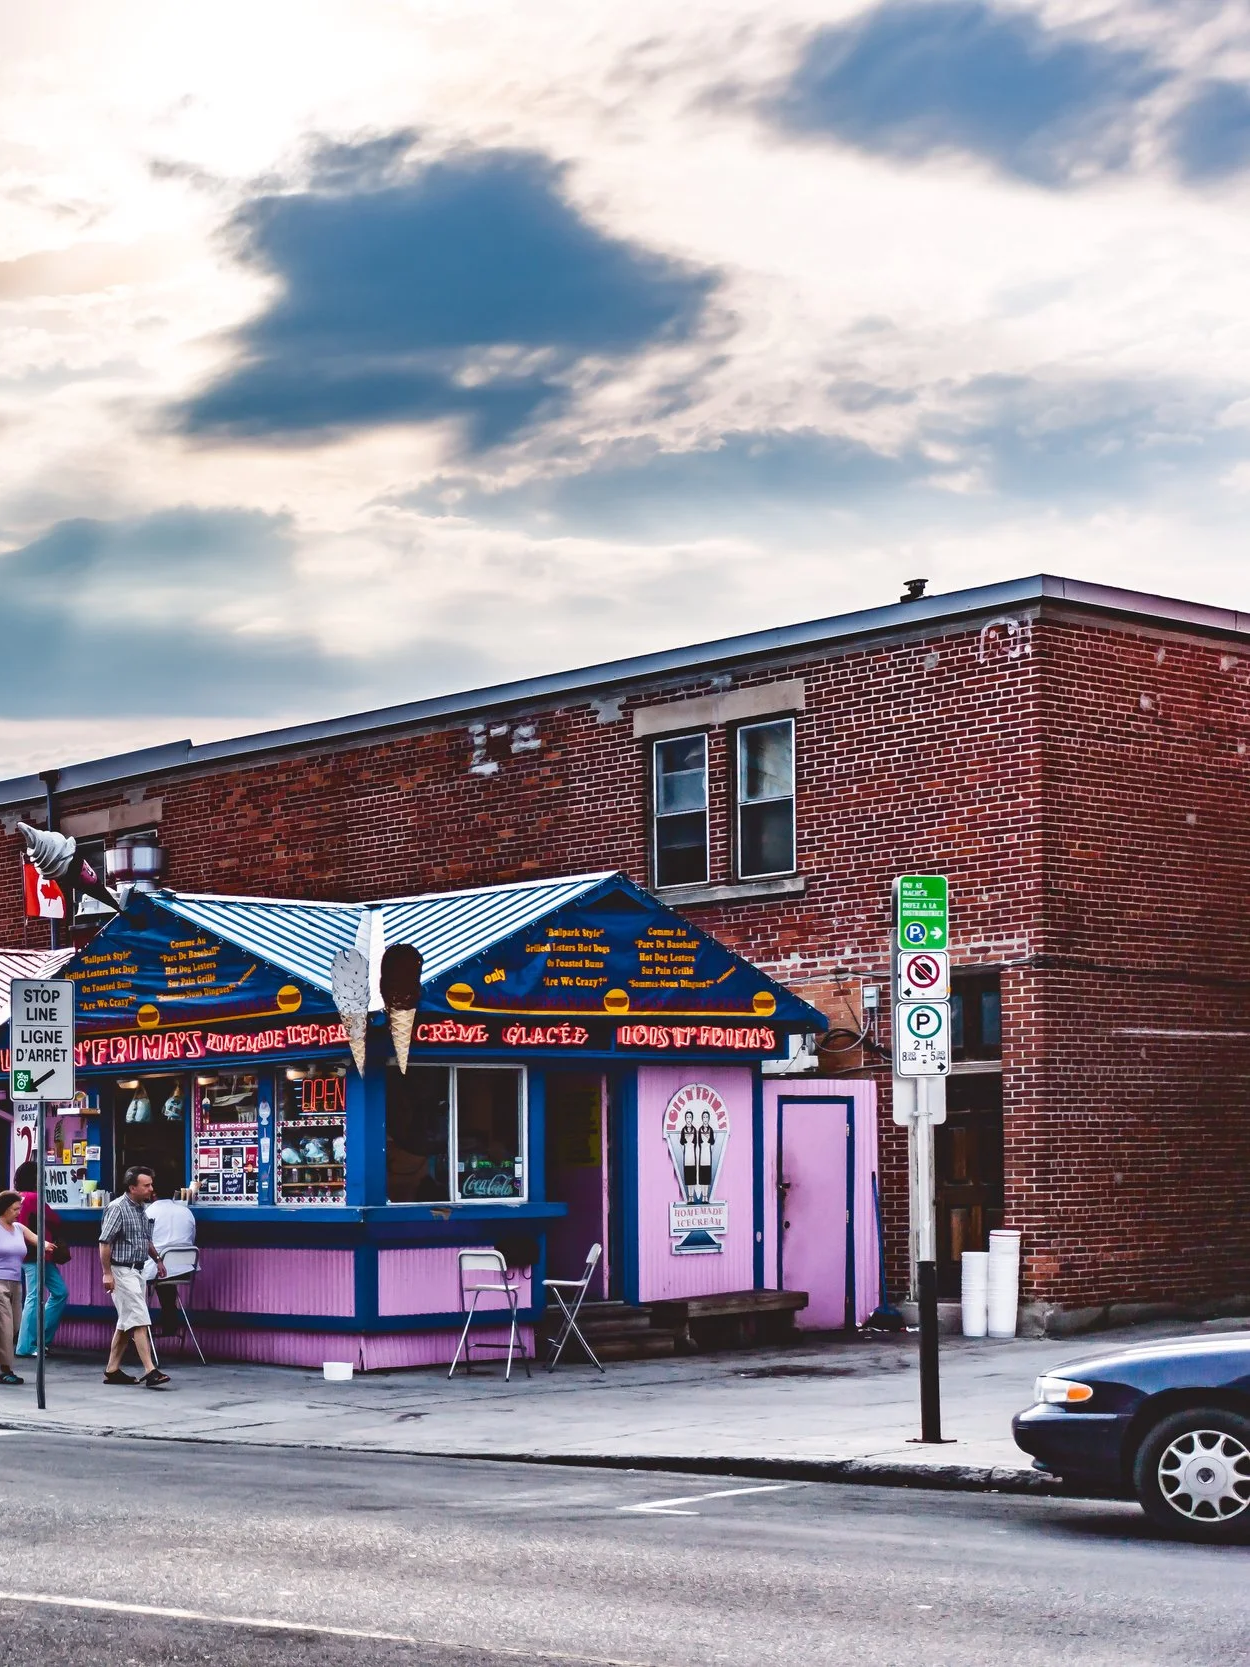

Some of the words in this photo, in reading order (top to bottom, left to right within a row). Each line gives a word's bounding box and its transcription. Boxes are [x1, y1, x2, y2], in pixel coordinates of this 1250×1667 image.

[647, 927, 674, 936] Comme
[170, 938, 195, 949] Comme
[525, 943, 551, 953] Grilled
[577, 943, 592, 952] Hot
[593, 944, 610, 954] Dogs
[656, 940, 665, 949] De
[178, 951, 187, 960] De
[639, 953, 653, 961] Hot
[654, 953, 668, 963] Dog
[670, 953, 696, 962] Lesters
[165, 966, 179, 975] Hot
[179, 965, 192, 974] Dog
[193, 961, 217, 972] Lesters
[584, 960, 604, 968] Buns
[110, 966, 122, 975] Hot
[123, 965, 139, 975] Dogs
[641, 966, 654, 975] Sur
[655, 966, 671, 975] Pain
[181, 976, 196, 986] Pain
[484, 968, 506, 984] only
[560, 976, 574, 986] We
[82, 985, 91, 993] On
[92, 982, 116, 992] Toasted
[24, 989, 60, 1004] STOP
[97, 999, 108, 1008] We
[26, 1007, 58, 1021] LINE
[916, 1013, 930, 1031] P
[21, 1030, 63, 1044] LIGNE
[205, 1029, 286, 1053] HOMEMADE
[286, 1023, 351, 1046] ICECREA
[913, 1040, 921, 1051] 2
[925, 1040, 936, 1051] H.
[16, 1047, 68, 1063] D'ARRÊT
[902, 1051, 907, 1062] 8
[930, 1051, 936, 1061] 5
[302, 1077, 346, 1112] OPEN
[45, 1189, 68, 1204] DOGS
[674, 1206, 723, 1217] HOMEMADE
